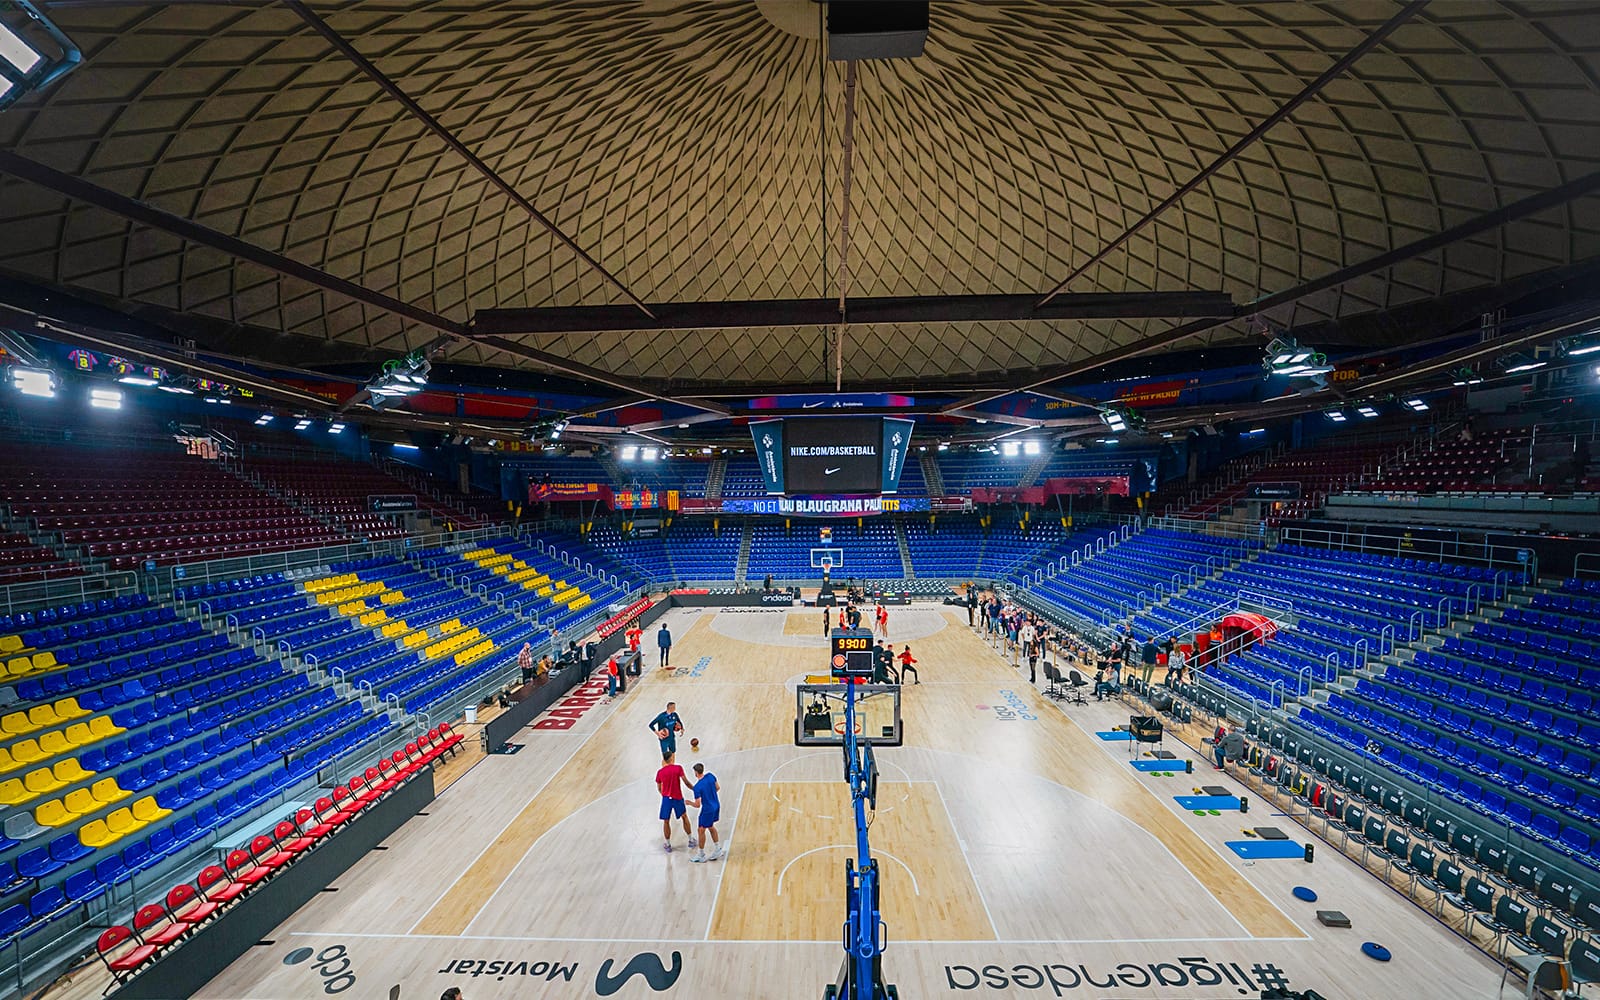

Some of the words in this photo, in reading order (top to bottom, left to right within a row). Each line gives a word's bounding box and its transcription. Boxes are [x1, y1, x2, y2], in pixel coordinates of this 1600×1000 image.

[1333, 370, 1359, 381] FOR
[790, 446, 876, 457] NIKE.COM/BASKETBALL
[753, 501, 765, 512] NO
[768, 501, 776, 512] ET
[796, 499, 862, 513] BLAUGRANA
[762, 593, 792, 602] endesa
[310, 943, 357, 995] acb
[438, 958, 580, 982] Movistar
[944, 956, 1290, 997] #ligaendesa
